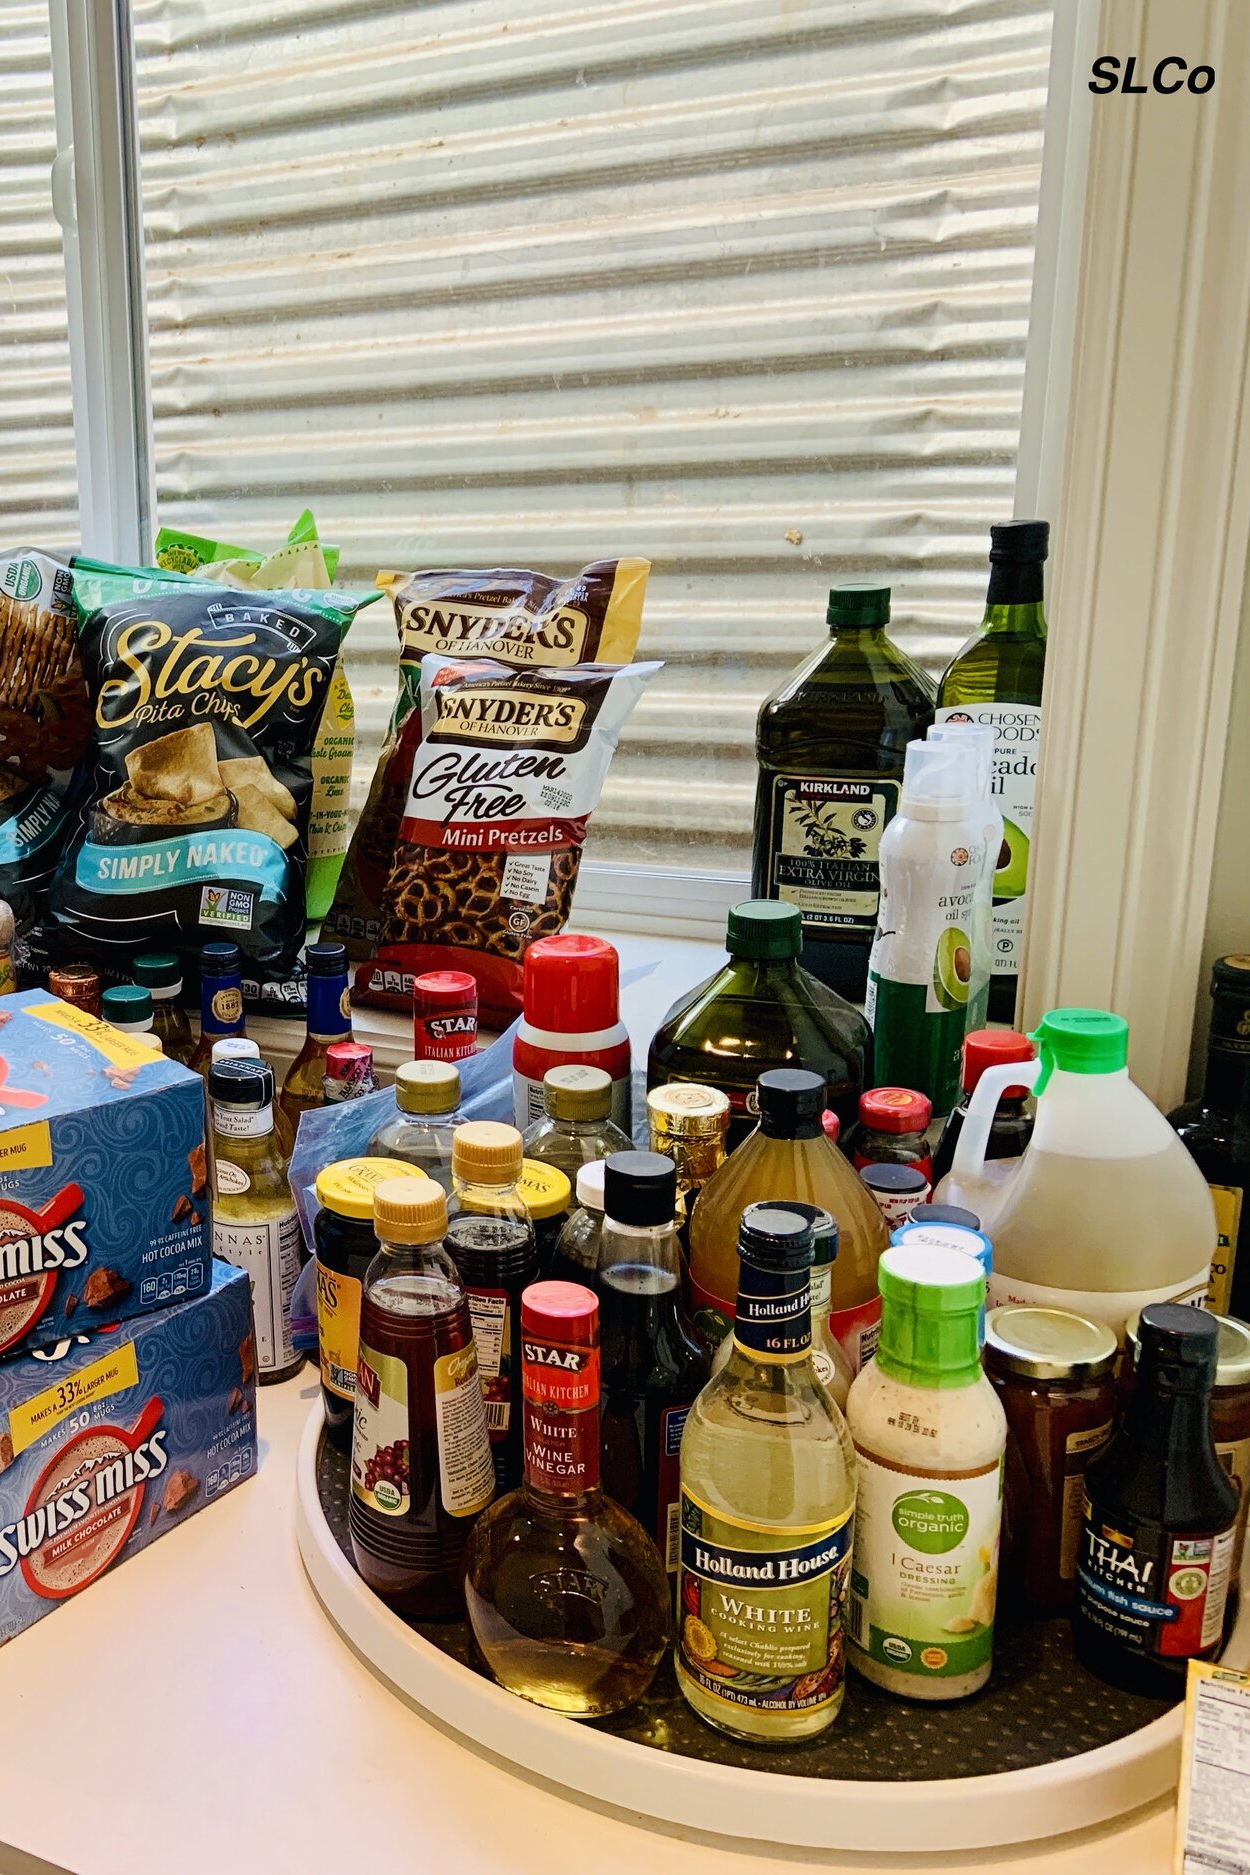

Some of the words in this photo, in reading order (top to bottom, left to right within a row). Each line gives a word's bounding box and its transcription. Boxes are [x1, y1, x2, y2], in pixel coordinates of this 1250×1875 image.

[4, 562, 21, 588] USDA
[18, 560, 33, 598] ORGANIC
[54, 568, 64, 592] NON
[405, 606, 576, 648] SNYDER'S
[436, 639, 458, 651] OF
[459, 639, 535, 660] HANOVER
[95, 620, 323, 729] Stacy's
[135, 700, 185, 729] Pita
[191, 691, 241, 723] Chips
[441, 697, 576, 728] SNYDER'S
[412, 750, 567, 800] Gluten
[801, 781, 871, 796] KIRKLAND
[440, 783, 527, 829] Free
[12, 806, 51, 848] SIMPLY
[441, 828, 483, 847] Mini
[488, 825, 564, 846] Pretzels
[97, 848, 182, 880] SIMPLY
[186, 841, 264, 869] NAKED
[514, 861, 531, 870] Great
[530, 863, 546, 873] Taste
[790, 858, 815, 867] 100%
[819, 861, 870, 872] ITALIAN
[513, 867, 522, 876] No
[522, 868, 534, 878] Soy
[521, 876, 537, 886] Dairy
[778, 865, 826, 881] EXTRA
[829, 869, 880, 883] VIRGIN
[804, 878, 833, 888] OLIVE
[835, 880, 853, 889] OIL
[518, 890, 530, 899] Egg
[220, 1000, 240, 1012] 1887
[430, 1016, 477, 1040] STAR
[50, 1033, 77, 1046] 50
[9, 1142, 27, 1155] MUG
[164, 1228, 190, 1243] CAFFEINE
[141, 1249, 159, 1264] HOT
[187, 1236, 203, 1250] MIX
[4, 1278, 26, 1290] COCOA
[143, 1281, 156, 1294] 160
[748, 1297, 800, 1318] Holland
[765, 1336, 781, 1350] 16
[525, 1343, 582, 1371] STAR
[56, 1379, 84, 1409] 33%
[549, 1382, 590, 1401] KITCHEN
[69, 1411, 91, 1435] 50
[530, 1415, 578, 1440] WHITE
[526, 1452, 586, 1475] VINEGAR
[532, 1442, 574, 1464] WINE
[898, 1507, 935, 1522] simple
[936, 1509, 964, 1522] truth
[52, 1538, 74, 1558] MILK
[73, 1505, 123, 1544] CHOCOLATE
[897, 1516, 965, 1535] organic
[693, 1546, 776, 1581] Holland
[778, 1545, 839, 1580] House
[1084, 1527, 1154, 1584] THAI
[900, 1557, 962, 1576] Caesar
[899, 1571, 957, 1585] DRESSING
[718, 1592, 813, 1625] WHITE
[1107, 1589, 1131, 1607] fish
[1131, 1601, 1174, 1618] sauce
[710, 1606, 778, 1634] COOKING
[782, 1621, 821, 1633] WINE
[723, 1642, 762, 1659] exclusively
[727, 1635, 748, 1647] select
[749, 1640, 778, 1651] Chablis
[779, 1642, 811, 1653] prepared
[722, 1650, 753, 1665] seasoned
[754, 1660, 771, 1668] with
[736, 1694, 749, 1706] 473
[761, 1700, 788, 1710] ALCOHOL
[788, 1700, 796, 1710] BY
